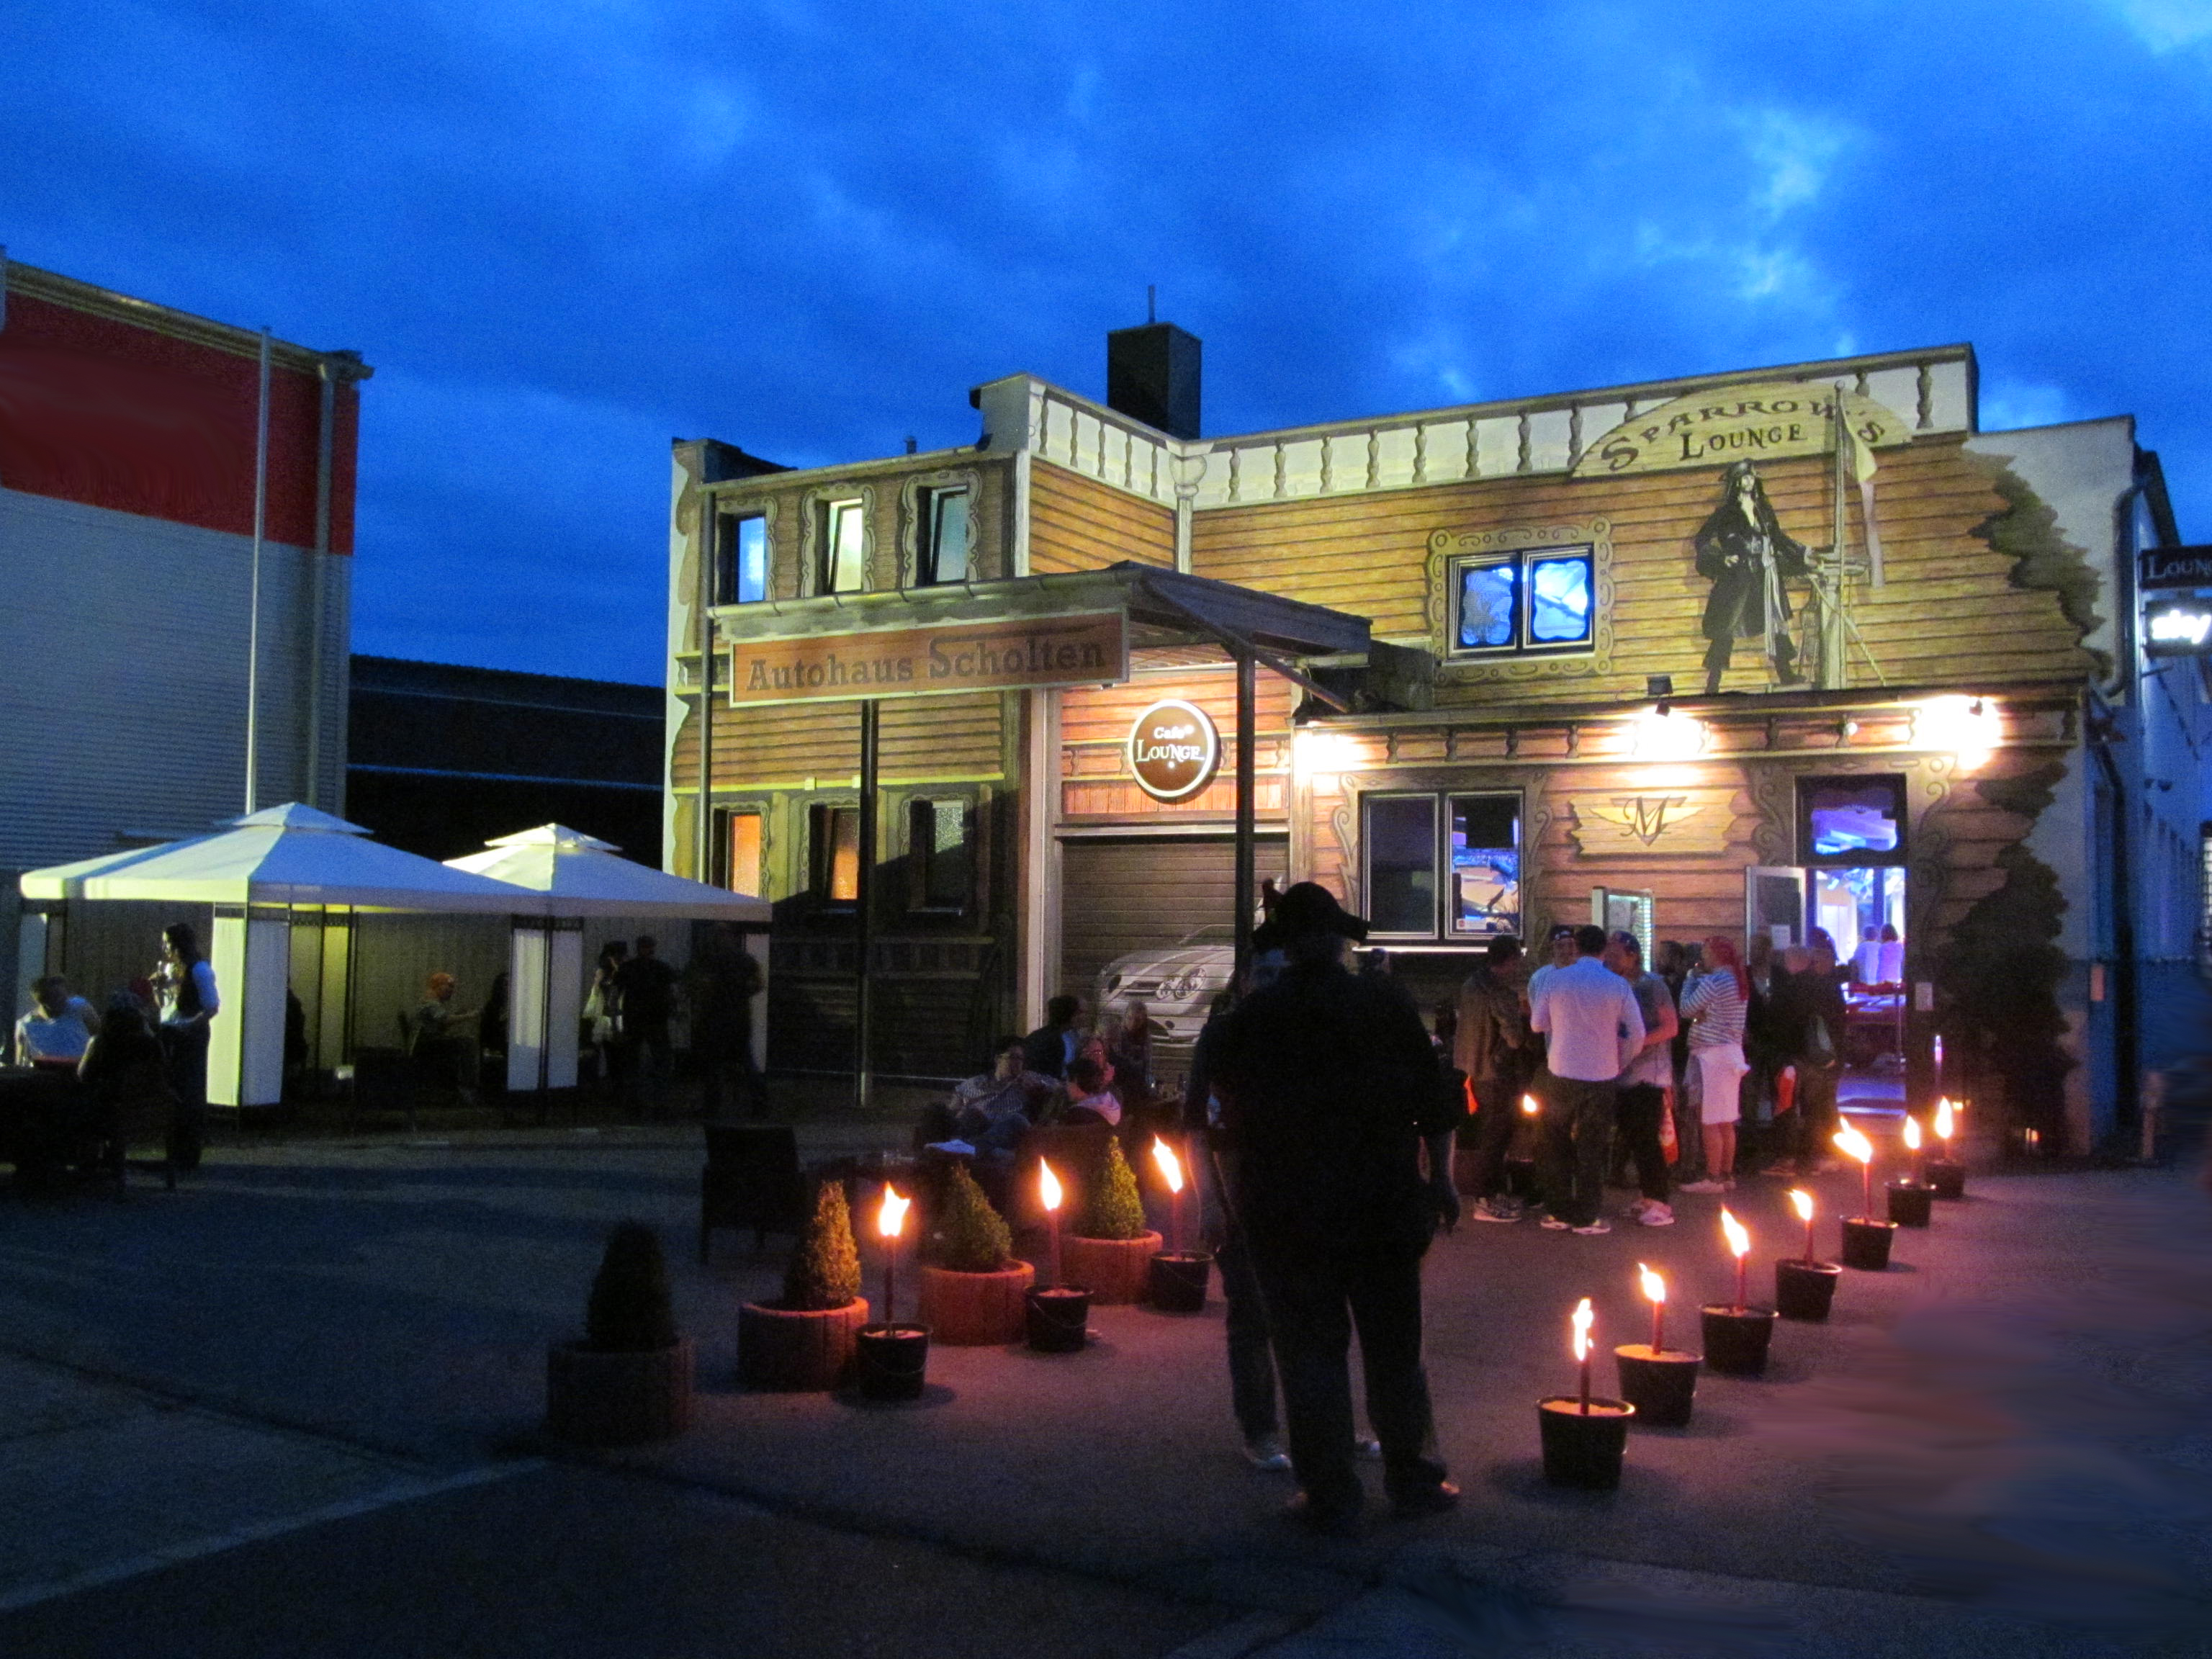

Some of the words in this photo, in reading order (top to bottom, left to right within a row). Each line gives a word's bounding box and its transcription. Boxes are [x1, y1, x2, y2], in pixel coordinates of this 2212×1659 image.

[1678, 423, 1807, 462] LOUNGE
[746, 653, 914, 692] Autohaus
[927, 624, 1107, 680] Scholten
[1136, 739, 1205, 763] LOUNGE
